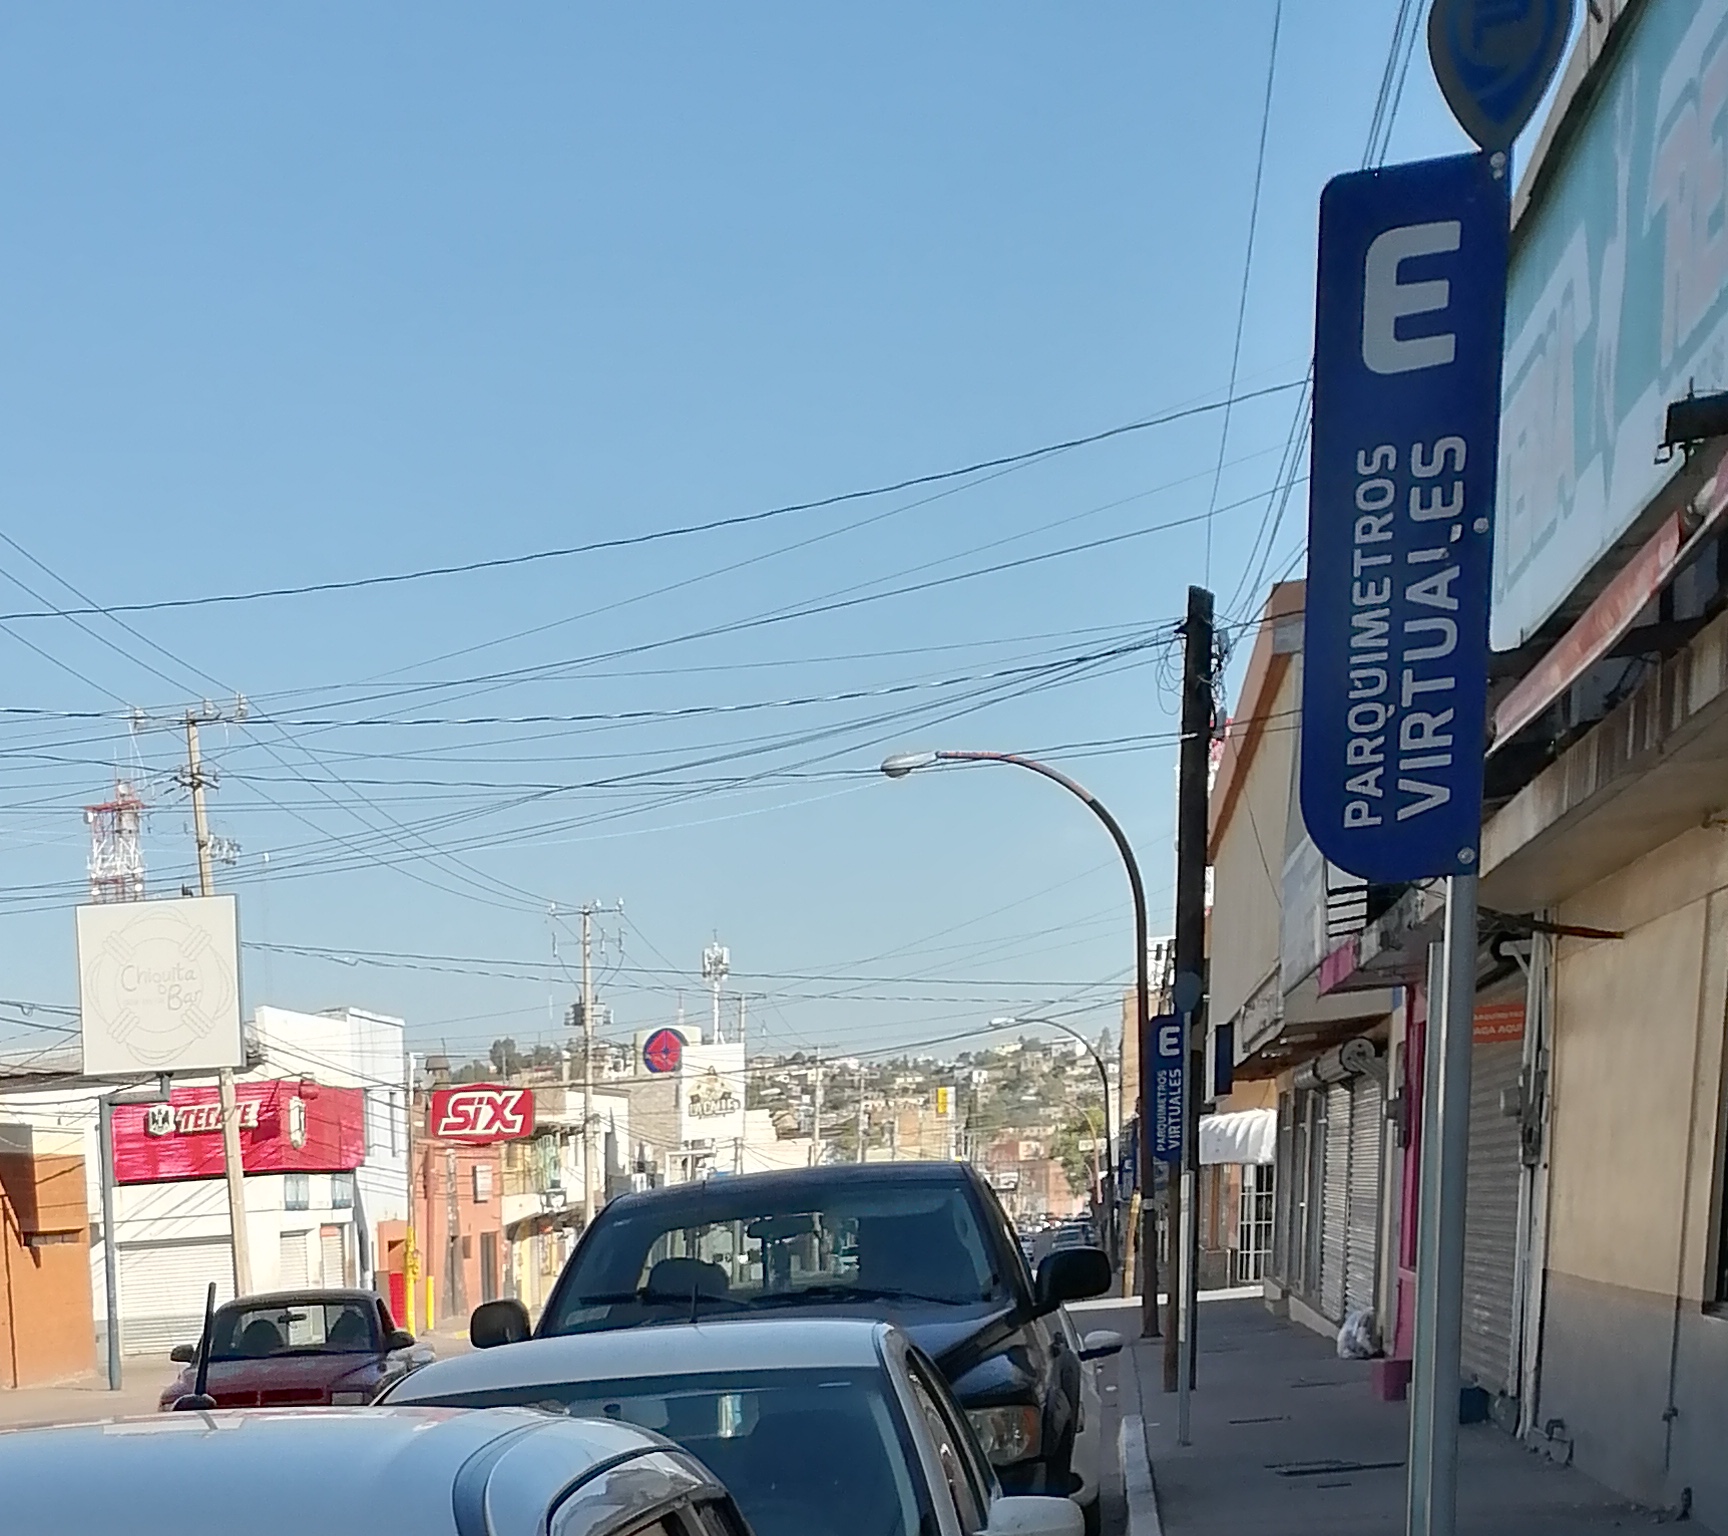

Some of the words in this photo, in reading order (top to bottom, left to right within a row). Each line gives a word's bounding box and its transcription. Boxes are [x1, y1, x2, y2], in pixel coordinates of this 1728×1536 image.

[1343, 443, 1400, 830] PARQUIMETROS
[1397, 433, 1468, 822] VIRTUALES
[1156, 1069, 1168, 1152] PARQUIMETROS
[1168, 1067, 1182, 1151] VIRTUALES
